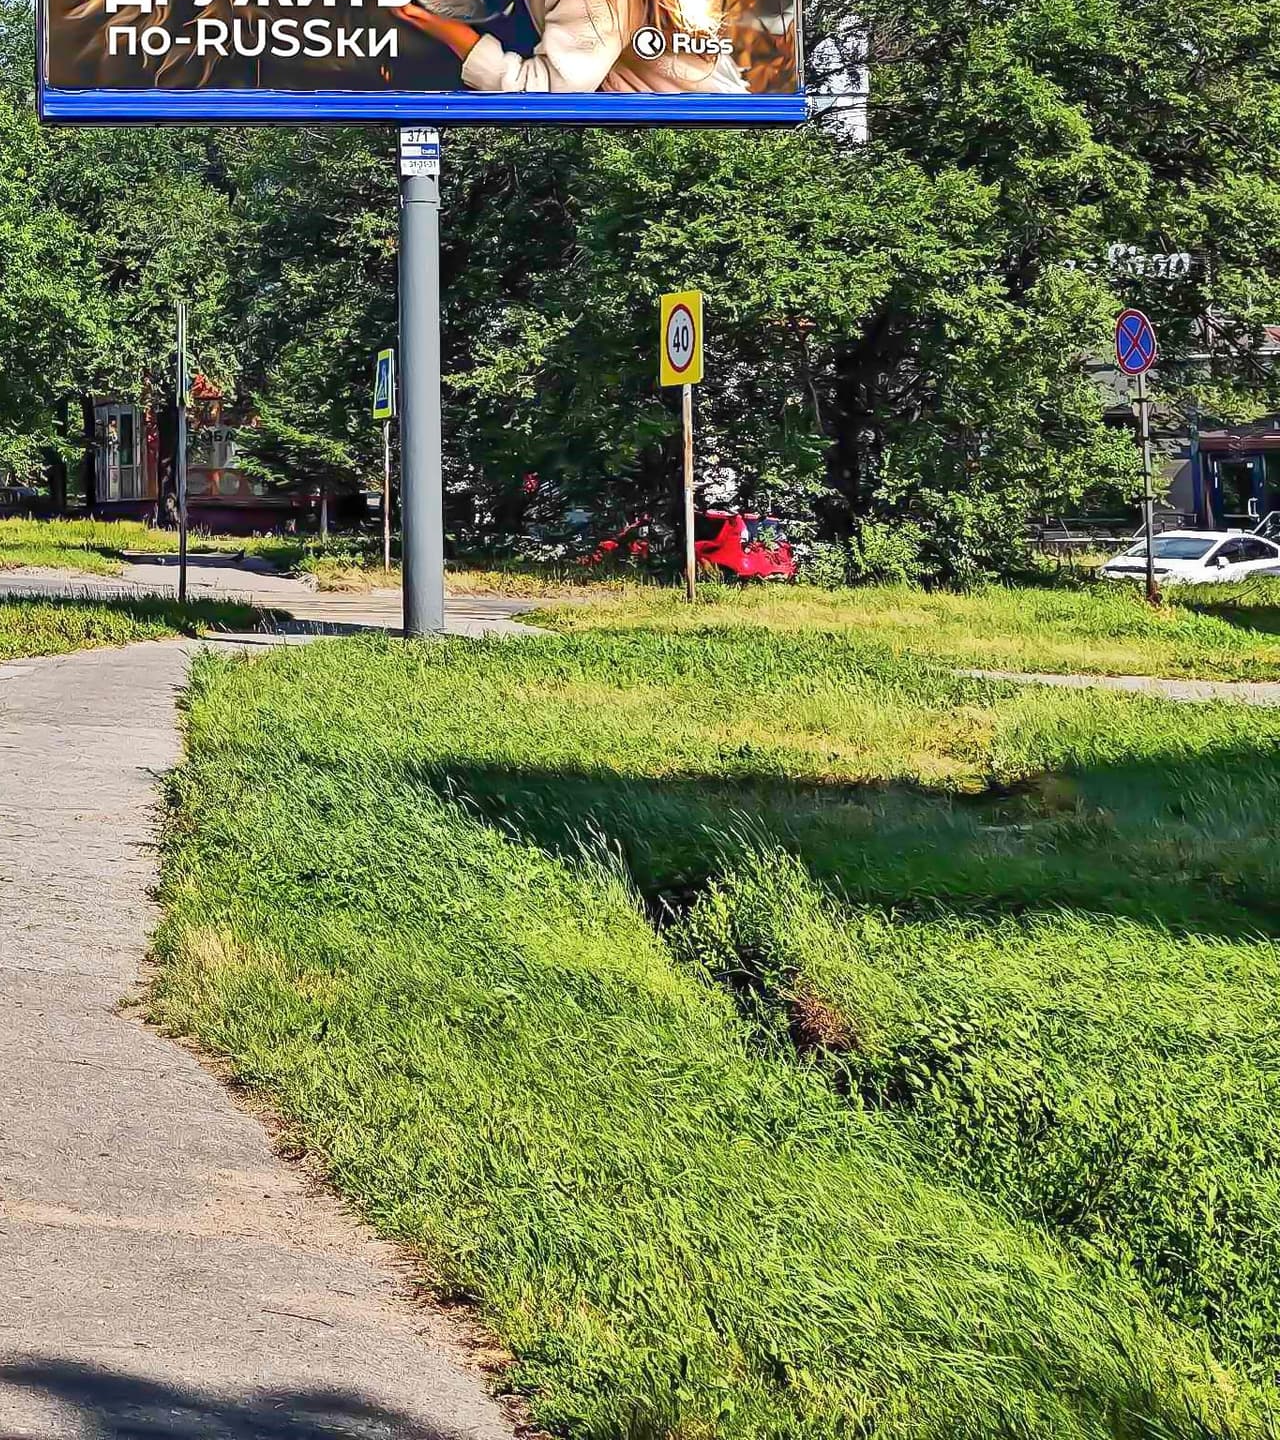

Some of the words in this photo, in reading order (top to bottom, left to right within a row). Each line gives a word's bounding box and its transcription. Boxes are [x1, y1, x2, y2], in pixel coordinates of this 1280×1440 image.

[108, 19, 399, 58] по-RUSSки
[672, 32, 734, 55] Russ
[673, 325, 689, 353] 40
